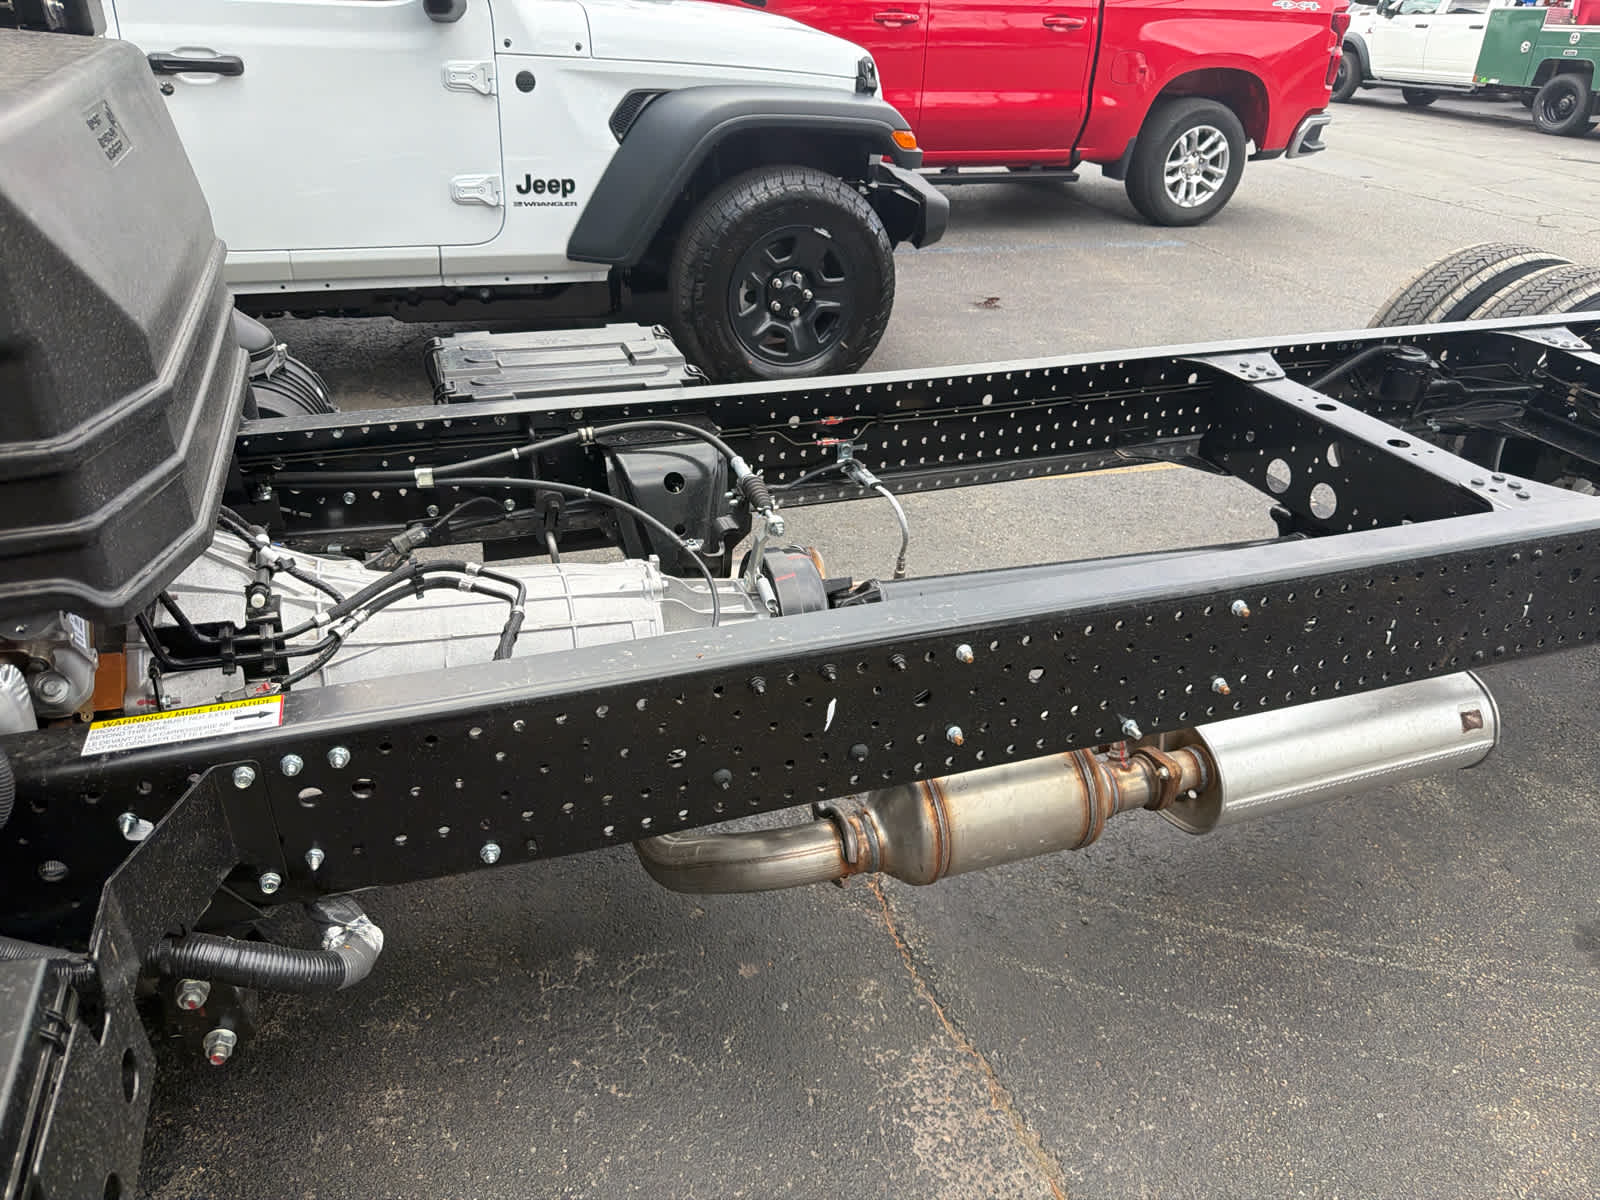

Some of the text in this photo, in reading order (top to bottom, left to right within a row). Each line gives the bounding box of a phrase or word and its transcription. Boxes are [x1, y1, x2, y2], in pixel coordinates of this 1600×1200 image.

[516, 174, 576, 198] Jeep
[90, 726, 120, 735] FRONT
[136, 720, 160, 728] BODY
[207, 708, 242, 718] EXTEND
[101, 714, 164, 728] WARNING
[174, 708, 201, 717] MISE
[229, 698, 272, 709] GARDE
[88, 730, 126, 741] BEYOND
[98, 736, 133, 746] DEVANT
